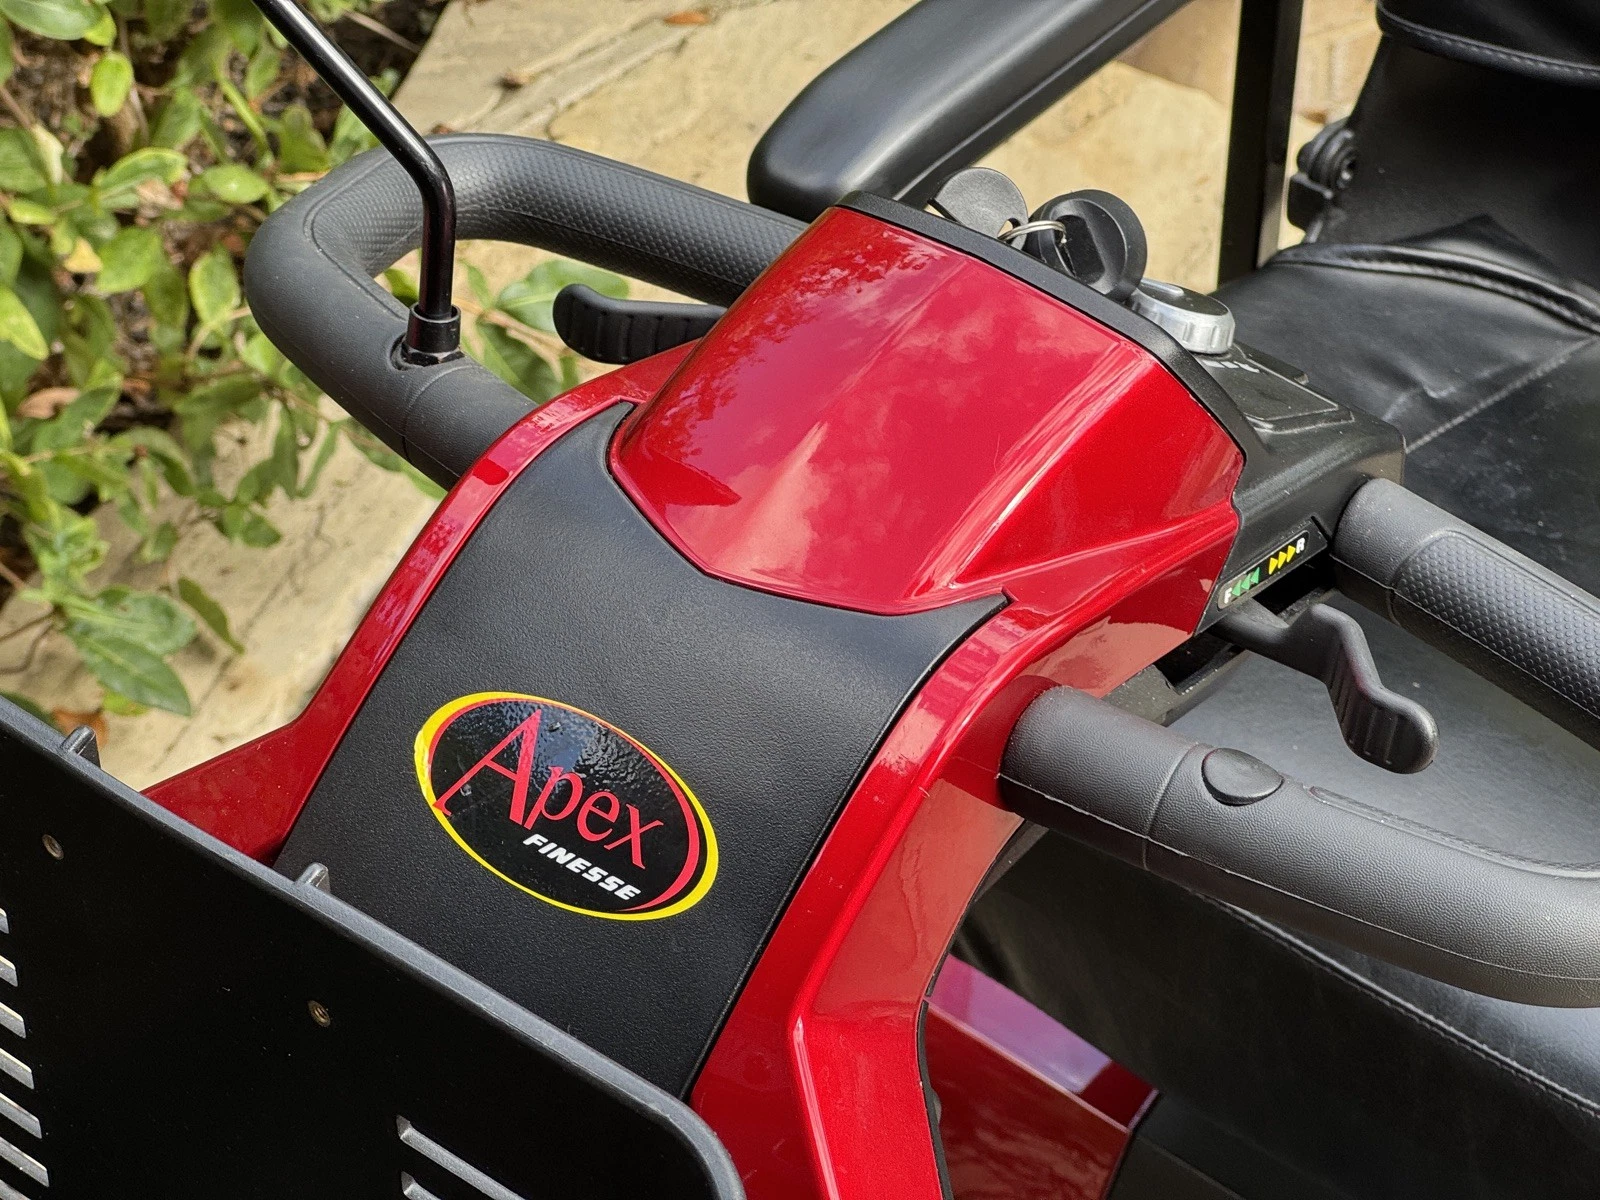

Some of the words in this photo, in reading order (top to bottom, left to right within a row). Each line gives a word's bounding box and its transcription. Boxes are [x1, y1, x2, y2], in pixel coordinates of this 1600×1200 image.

[1295, 537, 1305, 554] R
[432, 708, 664, 870] Apex
[522, 833, 641, 901] FINESSE
